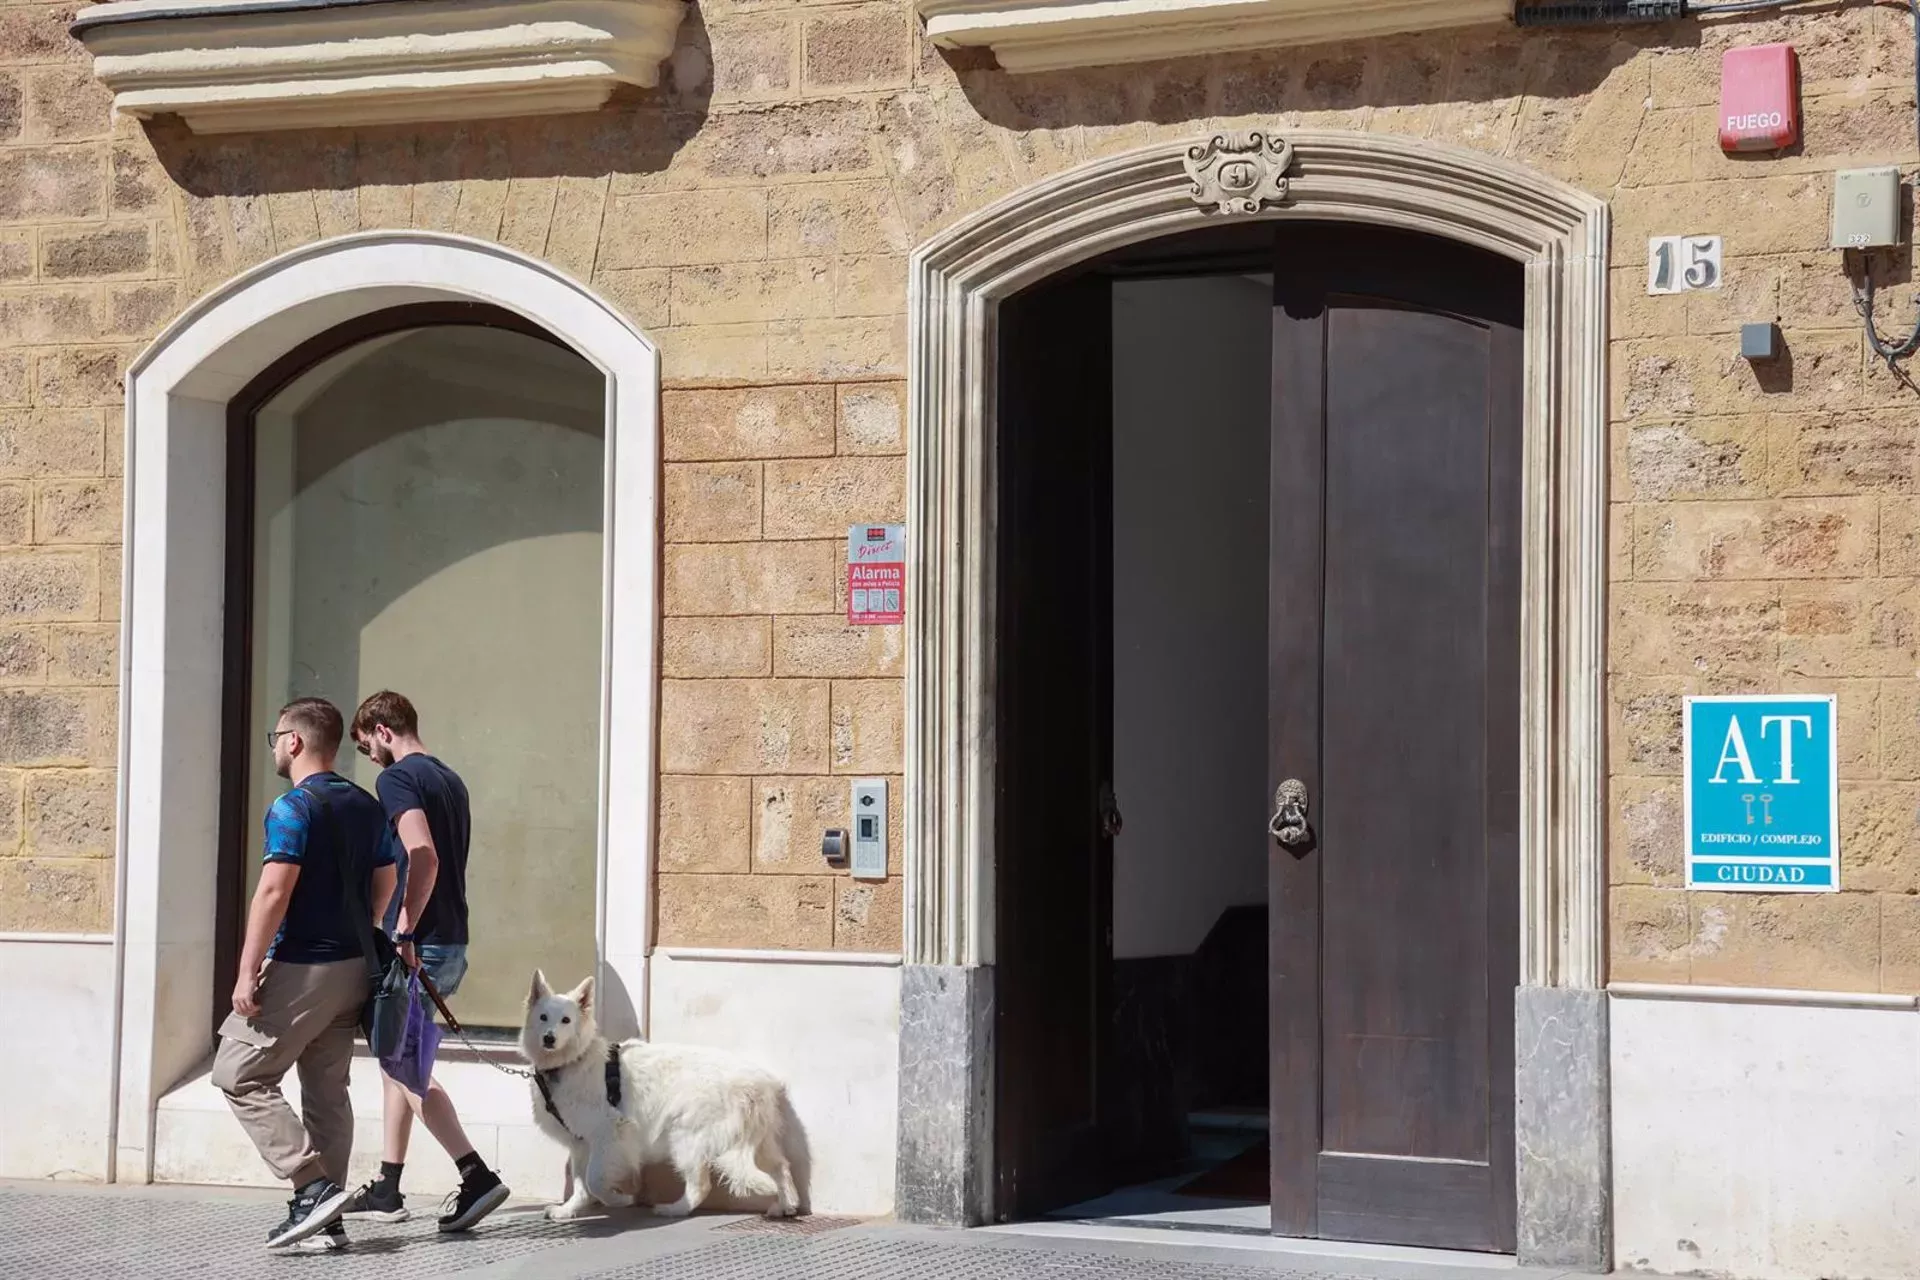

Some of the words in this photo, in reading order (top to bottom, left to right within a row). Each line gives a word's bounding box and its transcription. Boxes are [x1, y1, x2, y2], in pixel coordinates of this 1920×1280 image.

[1726, 112, 1781, 131] FUEGO
[1654, 240, 1719, 290] 15
[852, 566, 900, 580] Alarma
[1708, 714, 1812, 784] AT
[1701, 833, 1751, 844] EDIFICIO
[1760, 833, 1822, 846] COMPLEJO
[1717, 865, 1805, 883] CIUDAD
